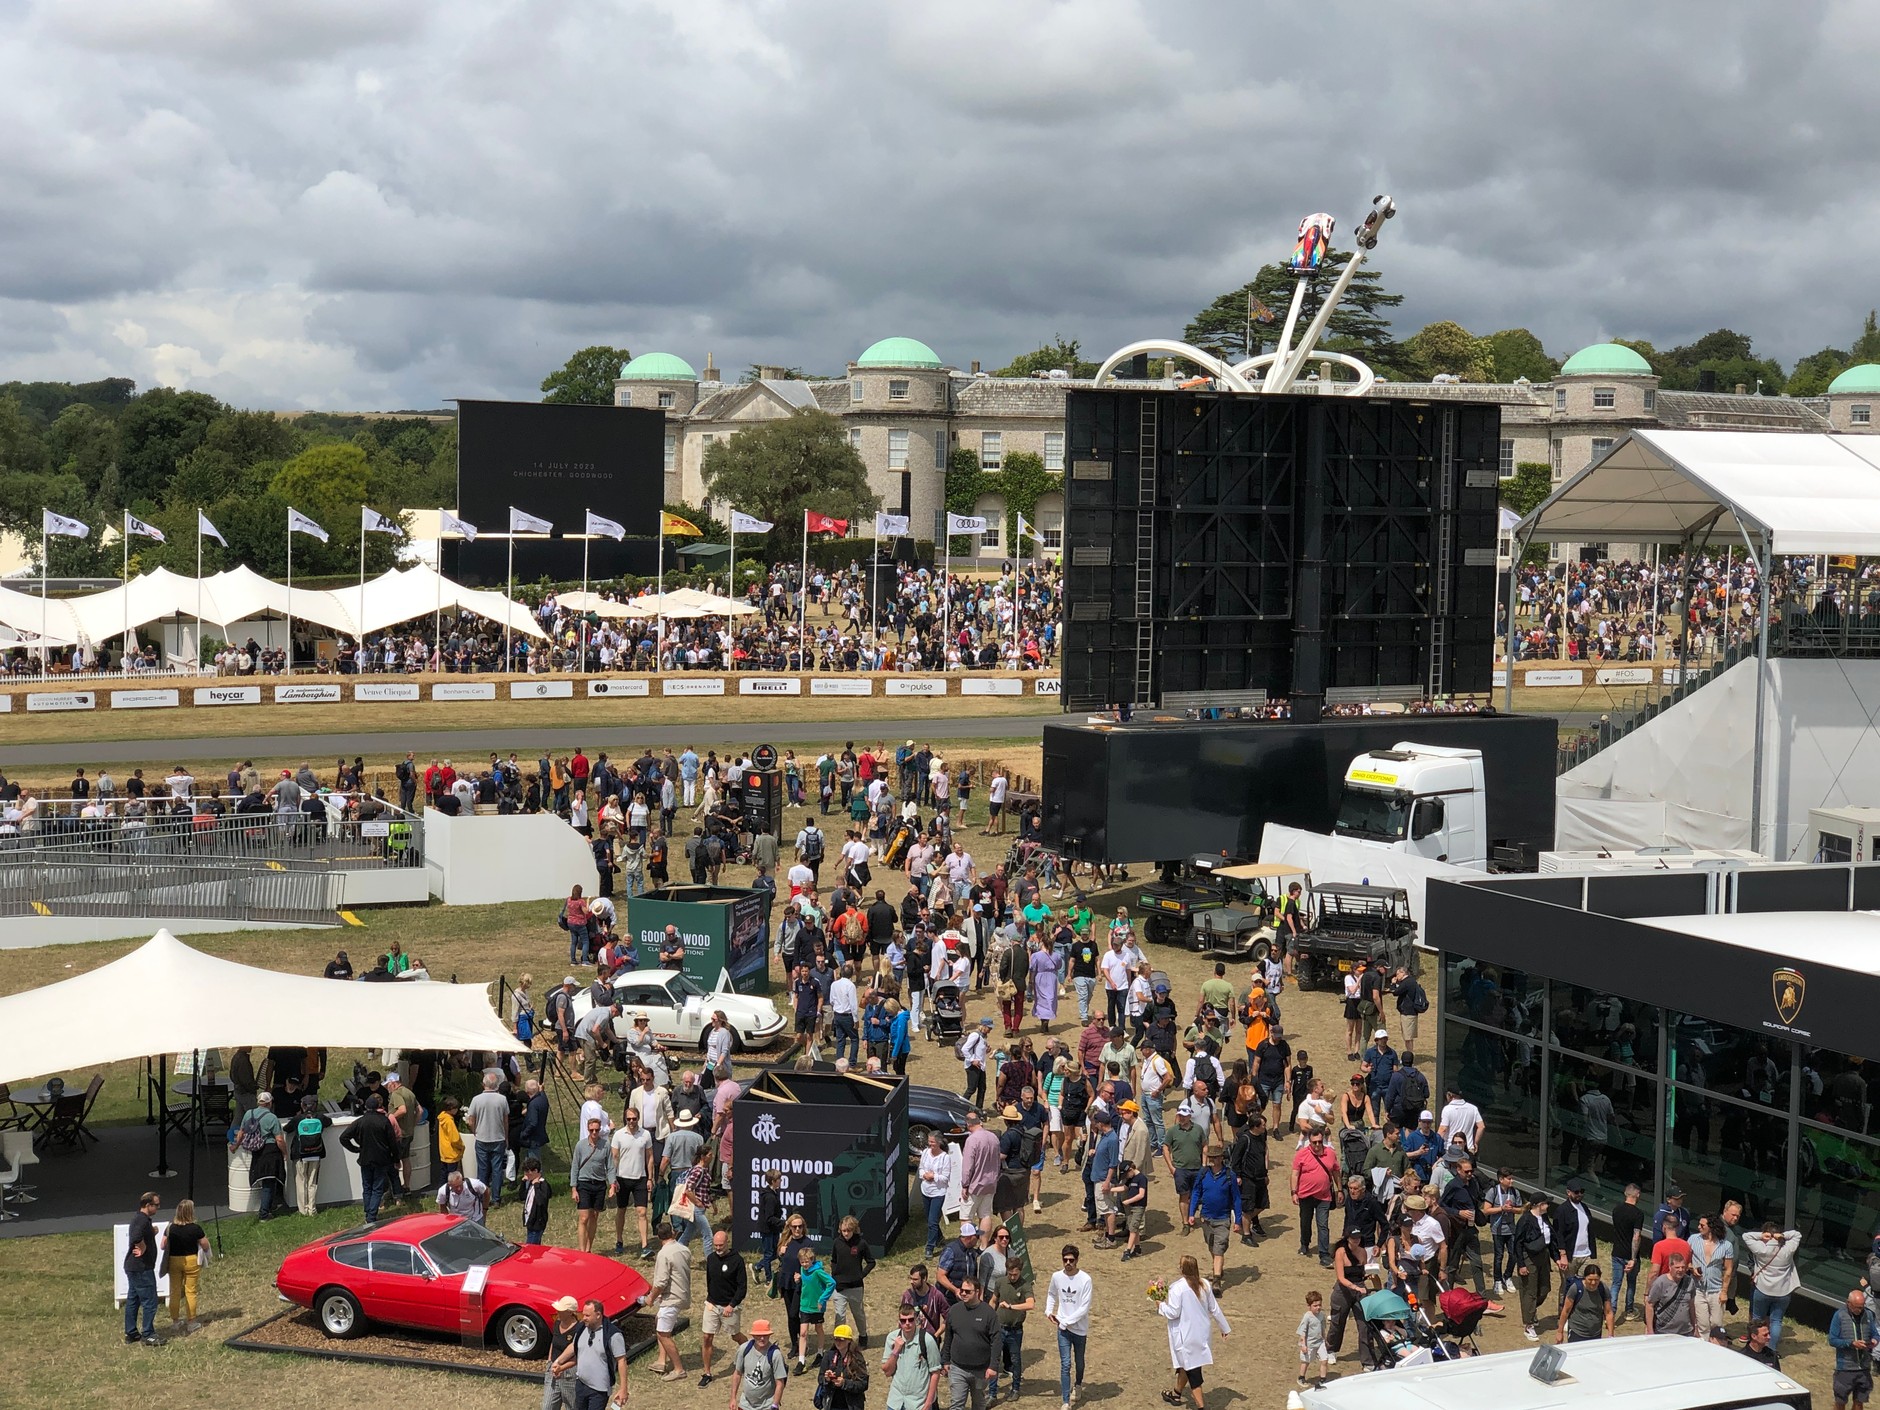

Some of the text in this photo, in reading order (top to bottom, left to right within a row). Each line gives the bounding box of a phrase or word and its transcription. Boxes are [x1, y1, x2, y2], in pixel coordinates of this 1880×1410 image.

[384, 687, 412, 697] Clicquot
[752, 682, 788, 691] PIRELLI
[910, 682, 933, 692] pulse
[209, 690, 245, 701] heycar
[279, 689, 337, 700] Lamborghini
[641, 930, 711, 947] GOOD WOOD
[1790, 1027, 1811, 1037] CORSE
[751, 1157, 834, 1175] GOODWOOD
[751, 1174, 790, 1189] ROD
[750, 1190, 805, 1207] RING
[750, 1206, 788, 1221] CB
